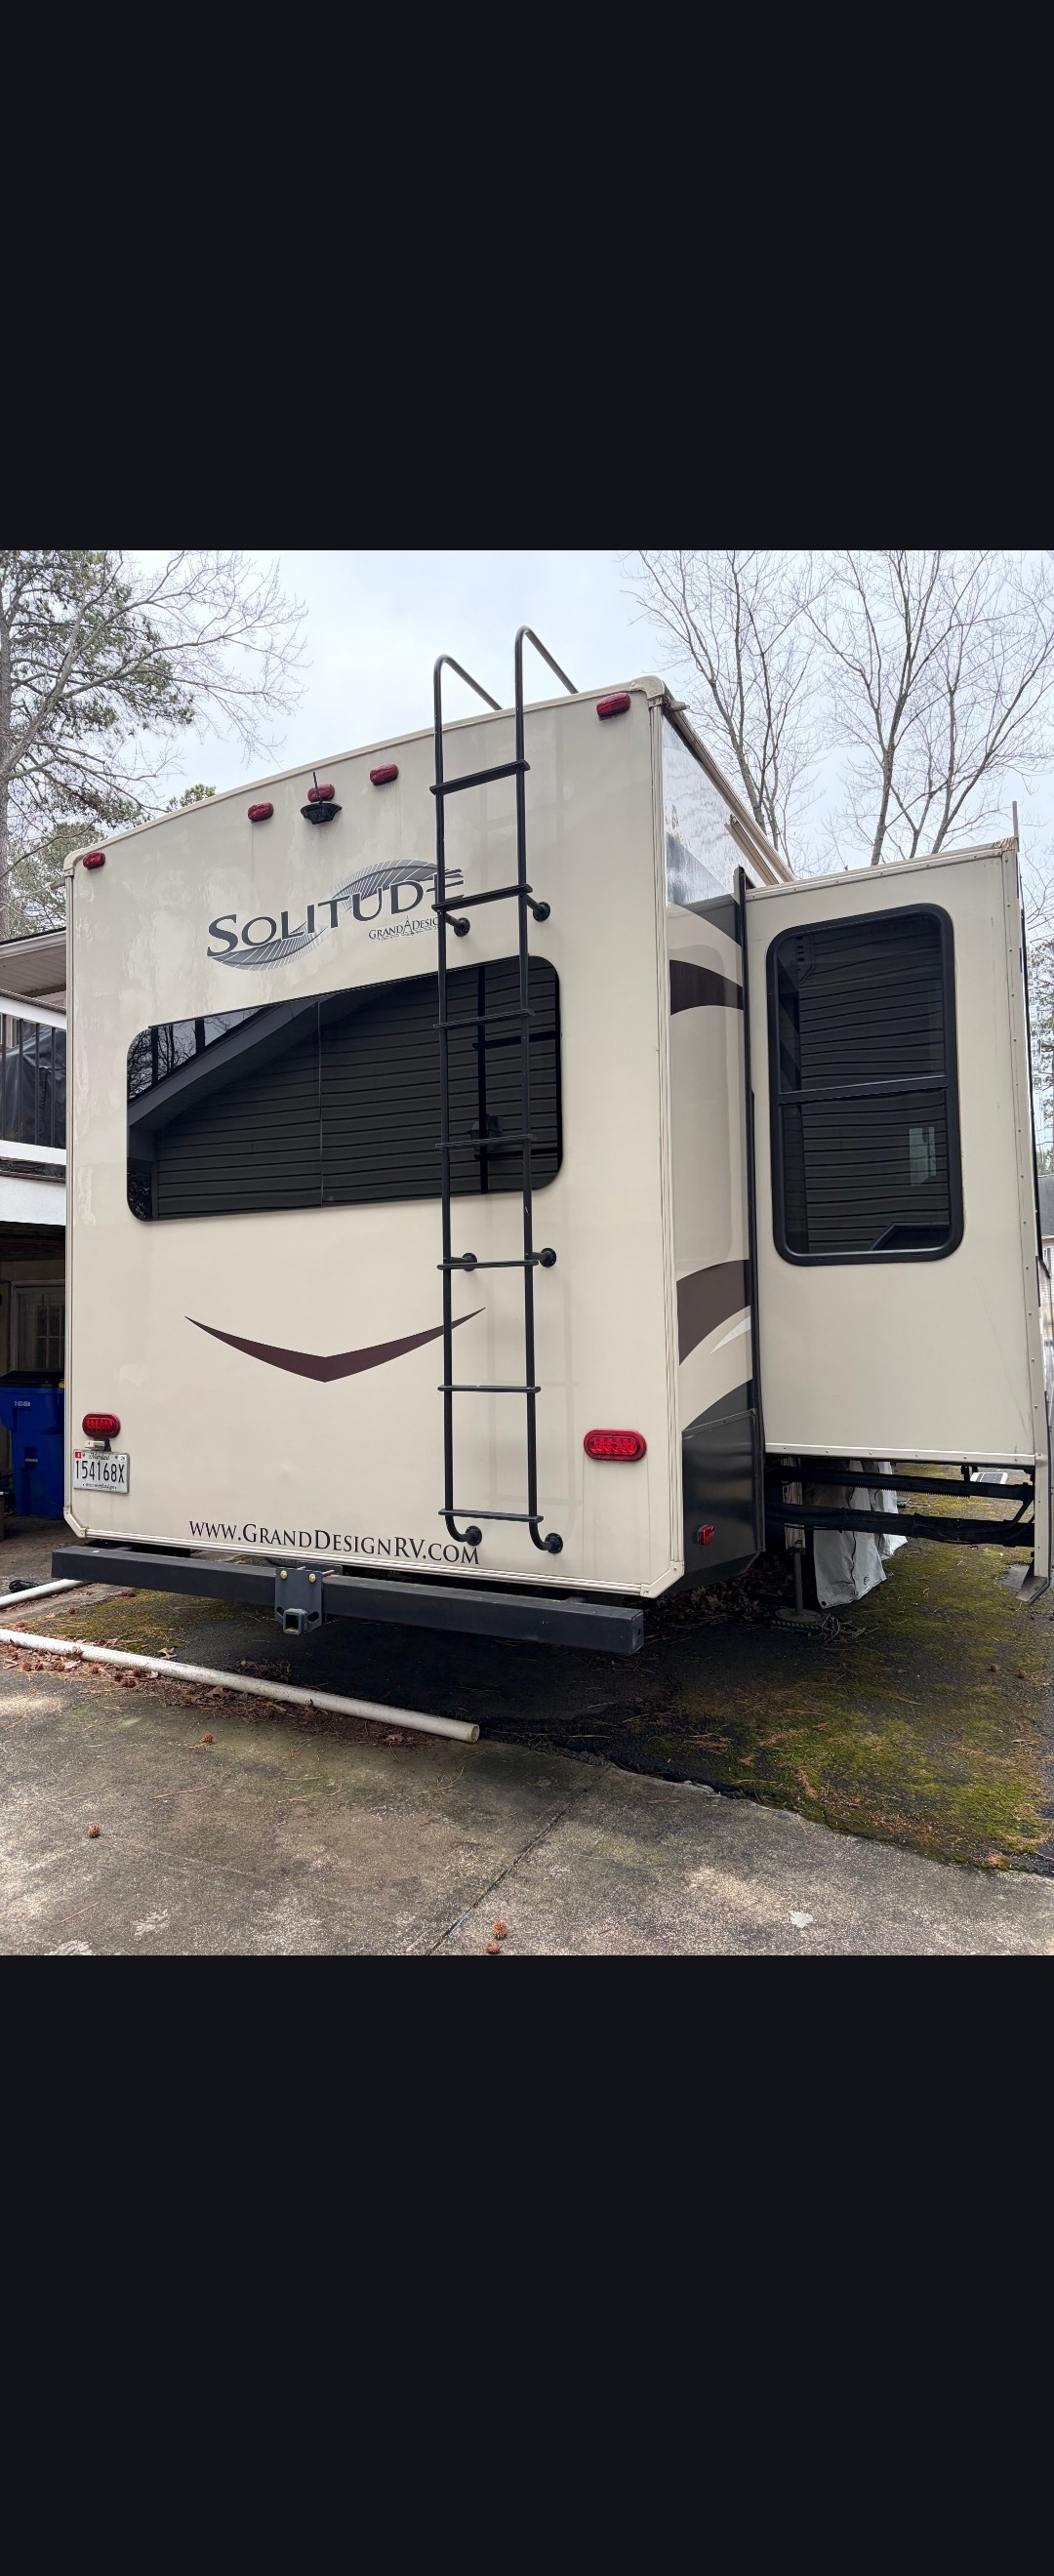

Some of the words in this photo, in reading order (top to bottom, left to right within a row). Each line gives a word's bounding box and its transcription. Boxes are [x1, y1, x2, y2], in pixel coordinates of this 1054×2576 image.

[206, 872, 465, 957] SOLITUDE
[368, 924, 404, 940] GRAND
[76, 1460, 125, 1483] 154168X
